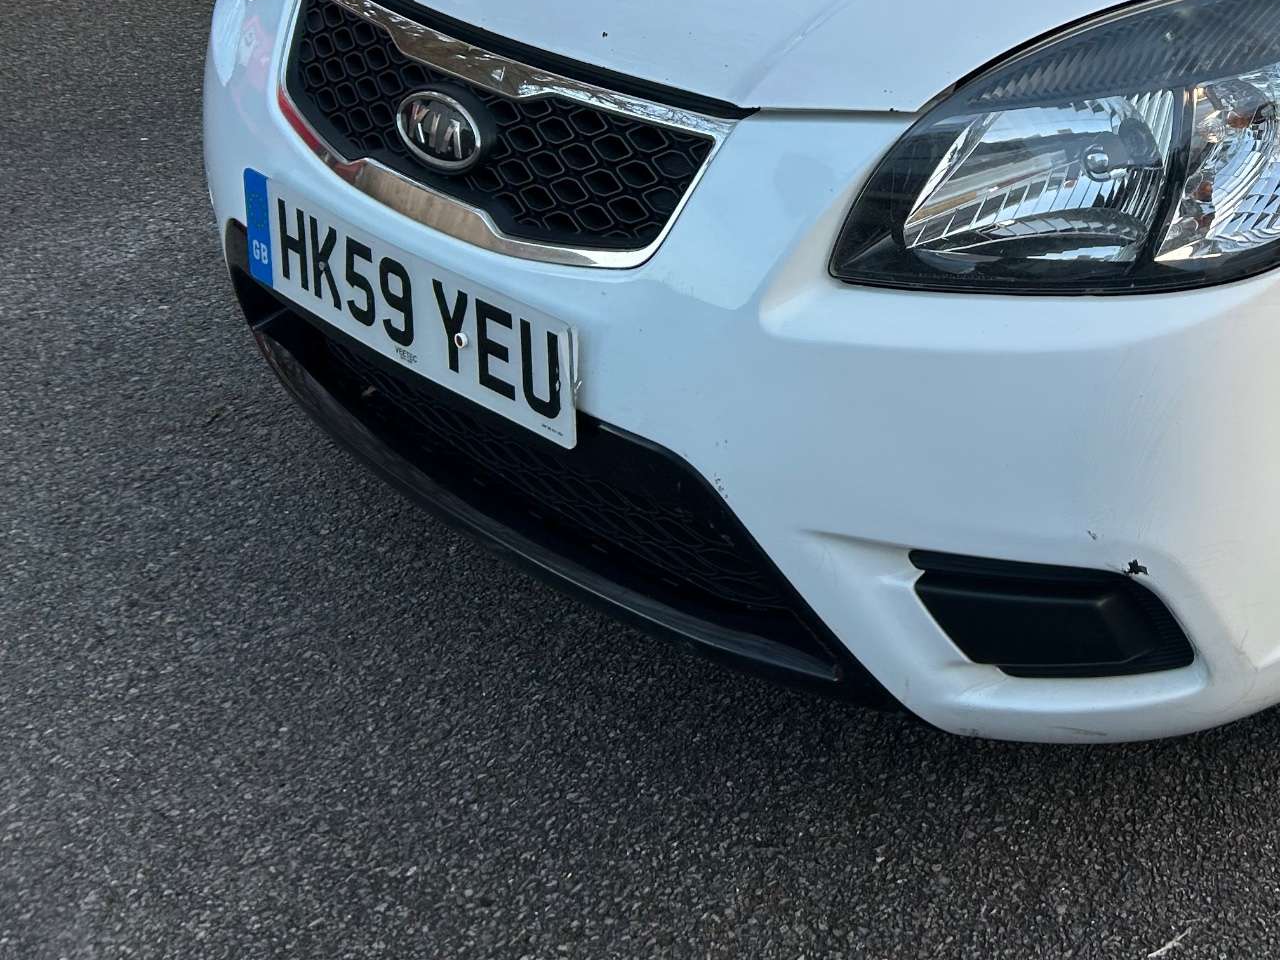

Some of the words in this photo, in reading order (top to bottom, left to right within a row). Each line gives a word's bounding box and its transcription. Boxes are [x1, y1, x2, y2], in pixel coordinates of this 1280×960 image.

[408, 101, 463, 160] KIA
[252, 239, 269, 266] GB
[277, 198, 415, 348] HK59
[431, 278, 562, 420] YEU
